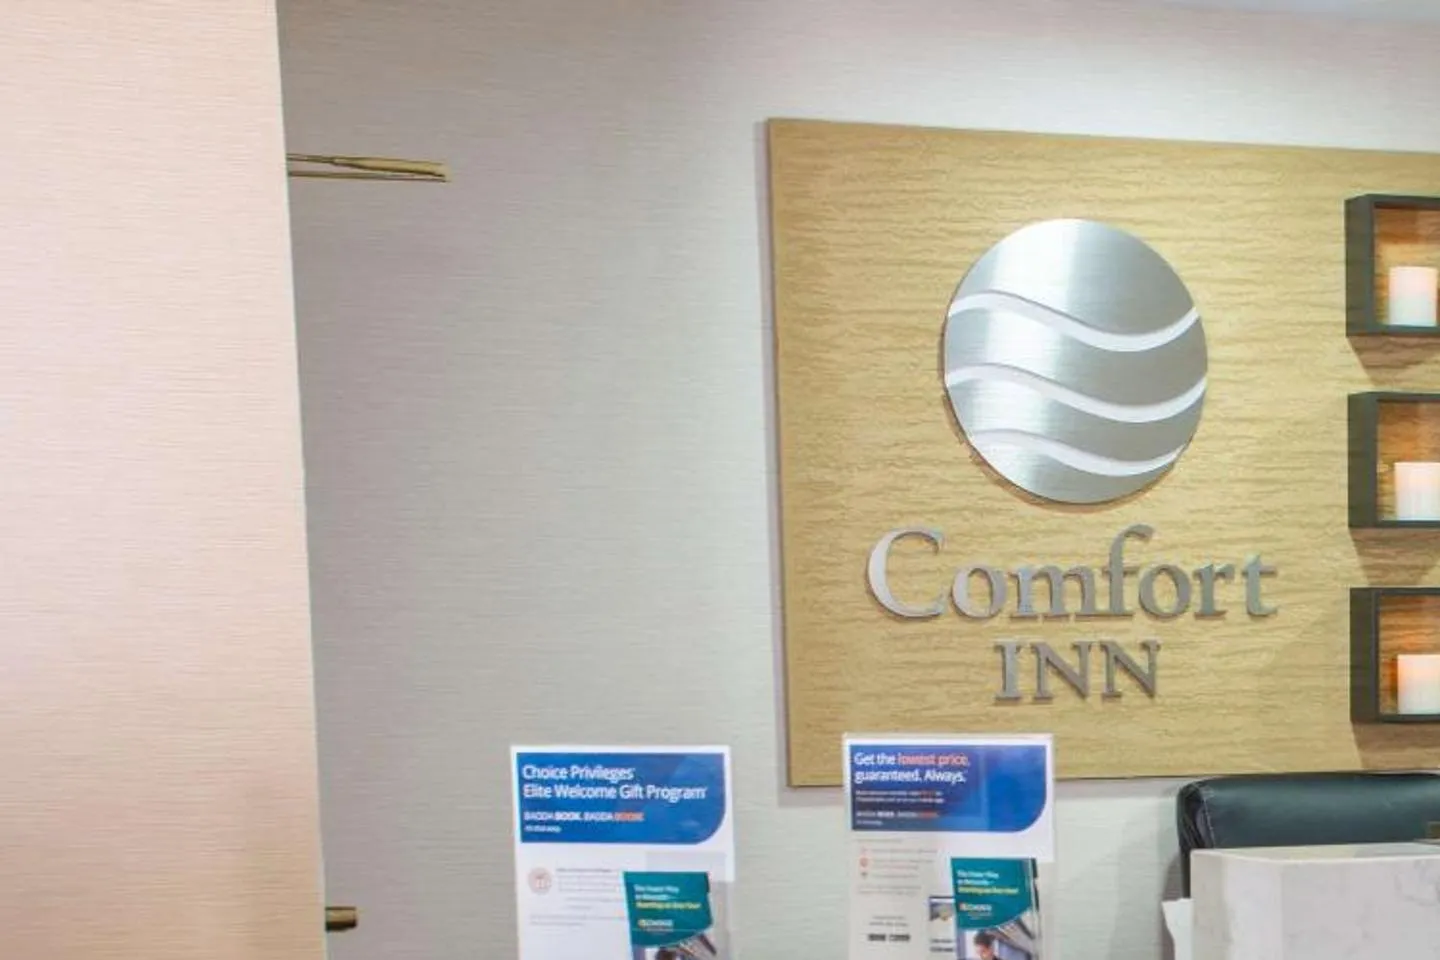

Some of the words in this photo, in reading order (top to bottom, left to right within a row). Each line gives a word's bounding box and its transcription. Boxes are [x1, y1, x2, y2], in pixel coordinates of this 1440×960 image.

[867, 524, 1278, 619] Comfort
[994, 637, 1162, 702] INN
[854, 753, 876, 766] Get
[877, 753, 896, 766] the
[898, 753, 936, 766] lowest
[522, 765, 568, 779] Choice
[570, 765, 634, 783] Privileges
[854, 770, 922, 784] guaranteed.
[523, 784, 552, 799] Elite
[554, 784, 617, 799] Welcome
[619, 784, 643, 799] Gift
[646, 785, 706, 803] Program
